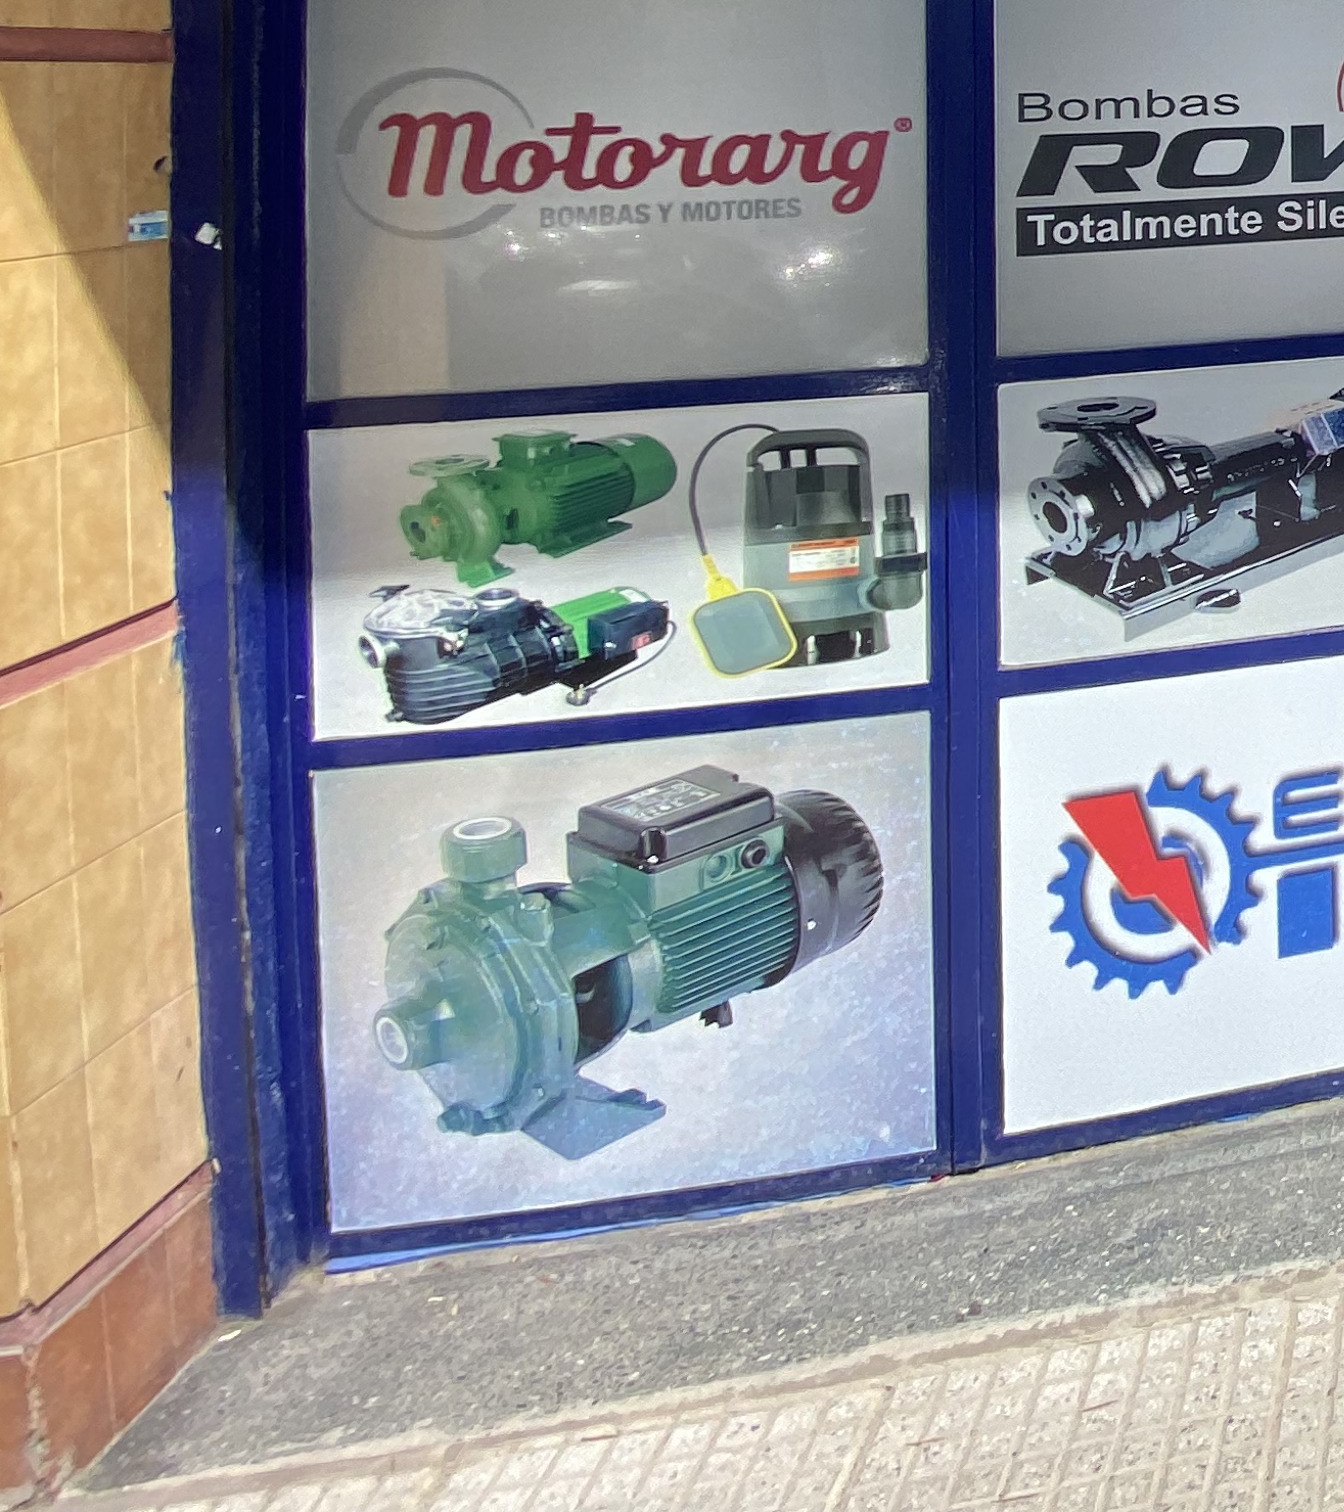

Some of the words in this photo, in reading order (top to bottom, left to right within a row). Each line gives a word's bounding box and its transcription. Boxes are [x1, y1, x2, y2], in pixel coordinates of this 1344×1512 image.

[1017, 89, 1241, 123] Bombas
[378, 111, 890, 215] Motorarg
[540, 203, 651, 229] BOMBAS
[657, 200, 674, 224] Y
[680, 197, 802, 223] MOTORES
[1027, 203, 1263, 247] Totalmente
